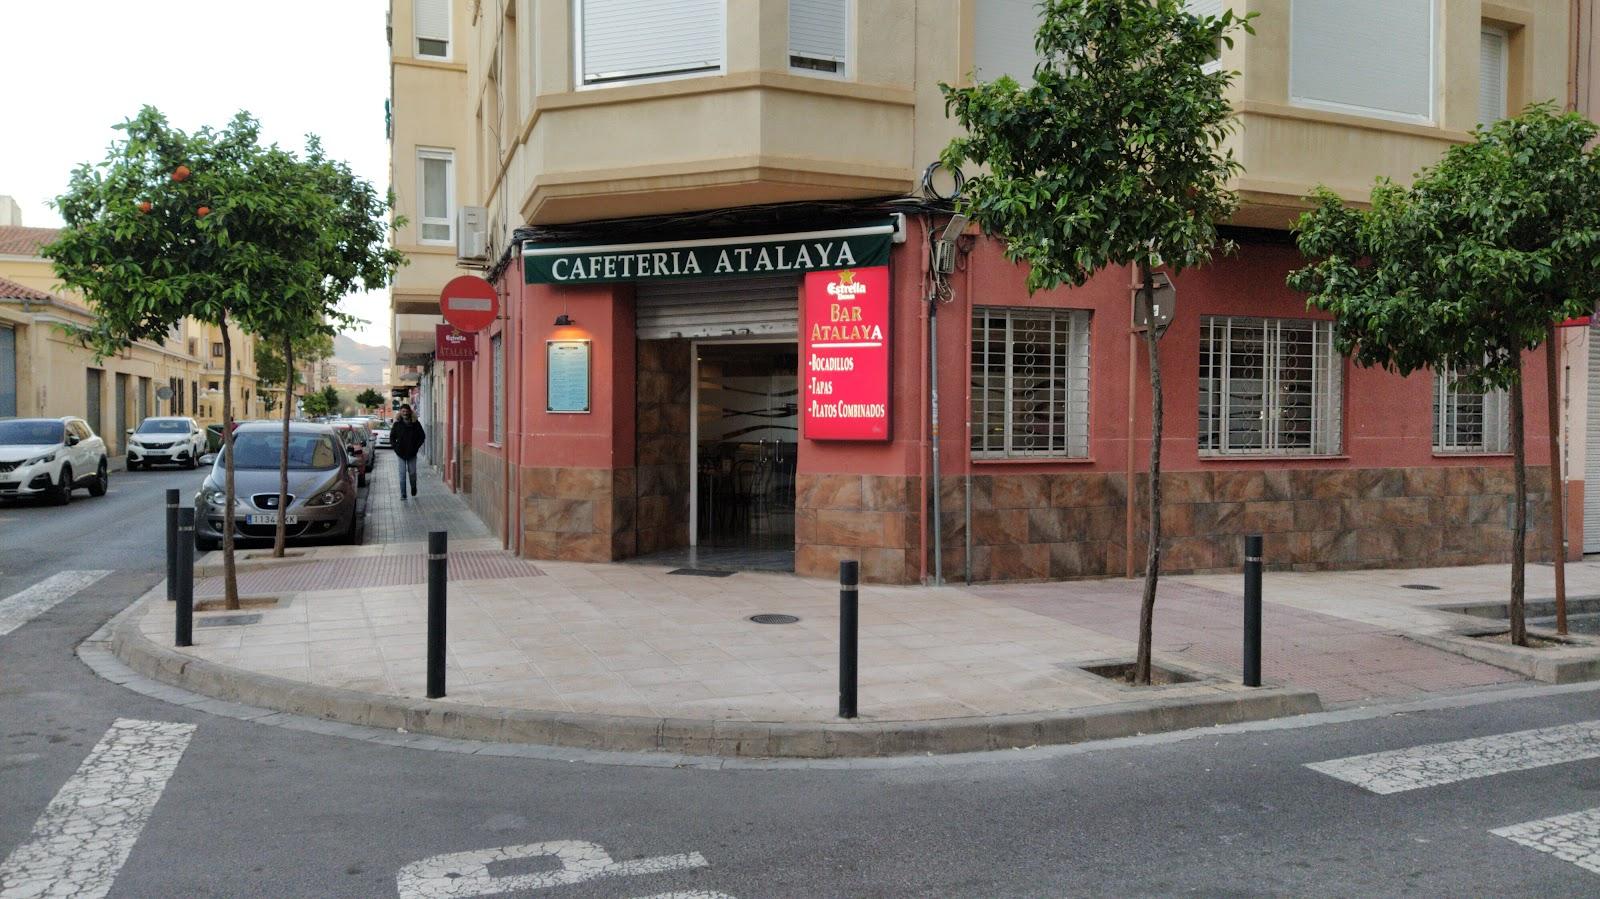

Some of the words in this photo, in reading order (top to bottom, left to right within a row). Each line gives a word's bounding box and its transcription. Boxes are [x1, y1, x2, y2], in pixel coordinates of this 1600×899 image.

[552, 250, 702, 281] CAFETERIA
[714, 240, 857, 274] ATALAYA
[827, 282, 866, 295] Estrella
[831, 304, 862, 322] BAR
[811, 323, 883, 341] ATALAYA
[812, 400, 837, 418] PLATOS
[838, 400, 885, 418] COMBINADOS
